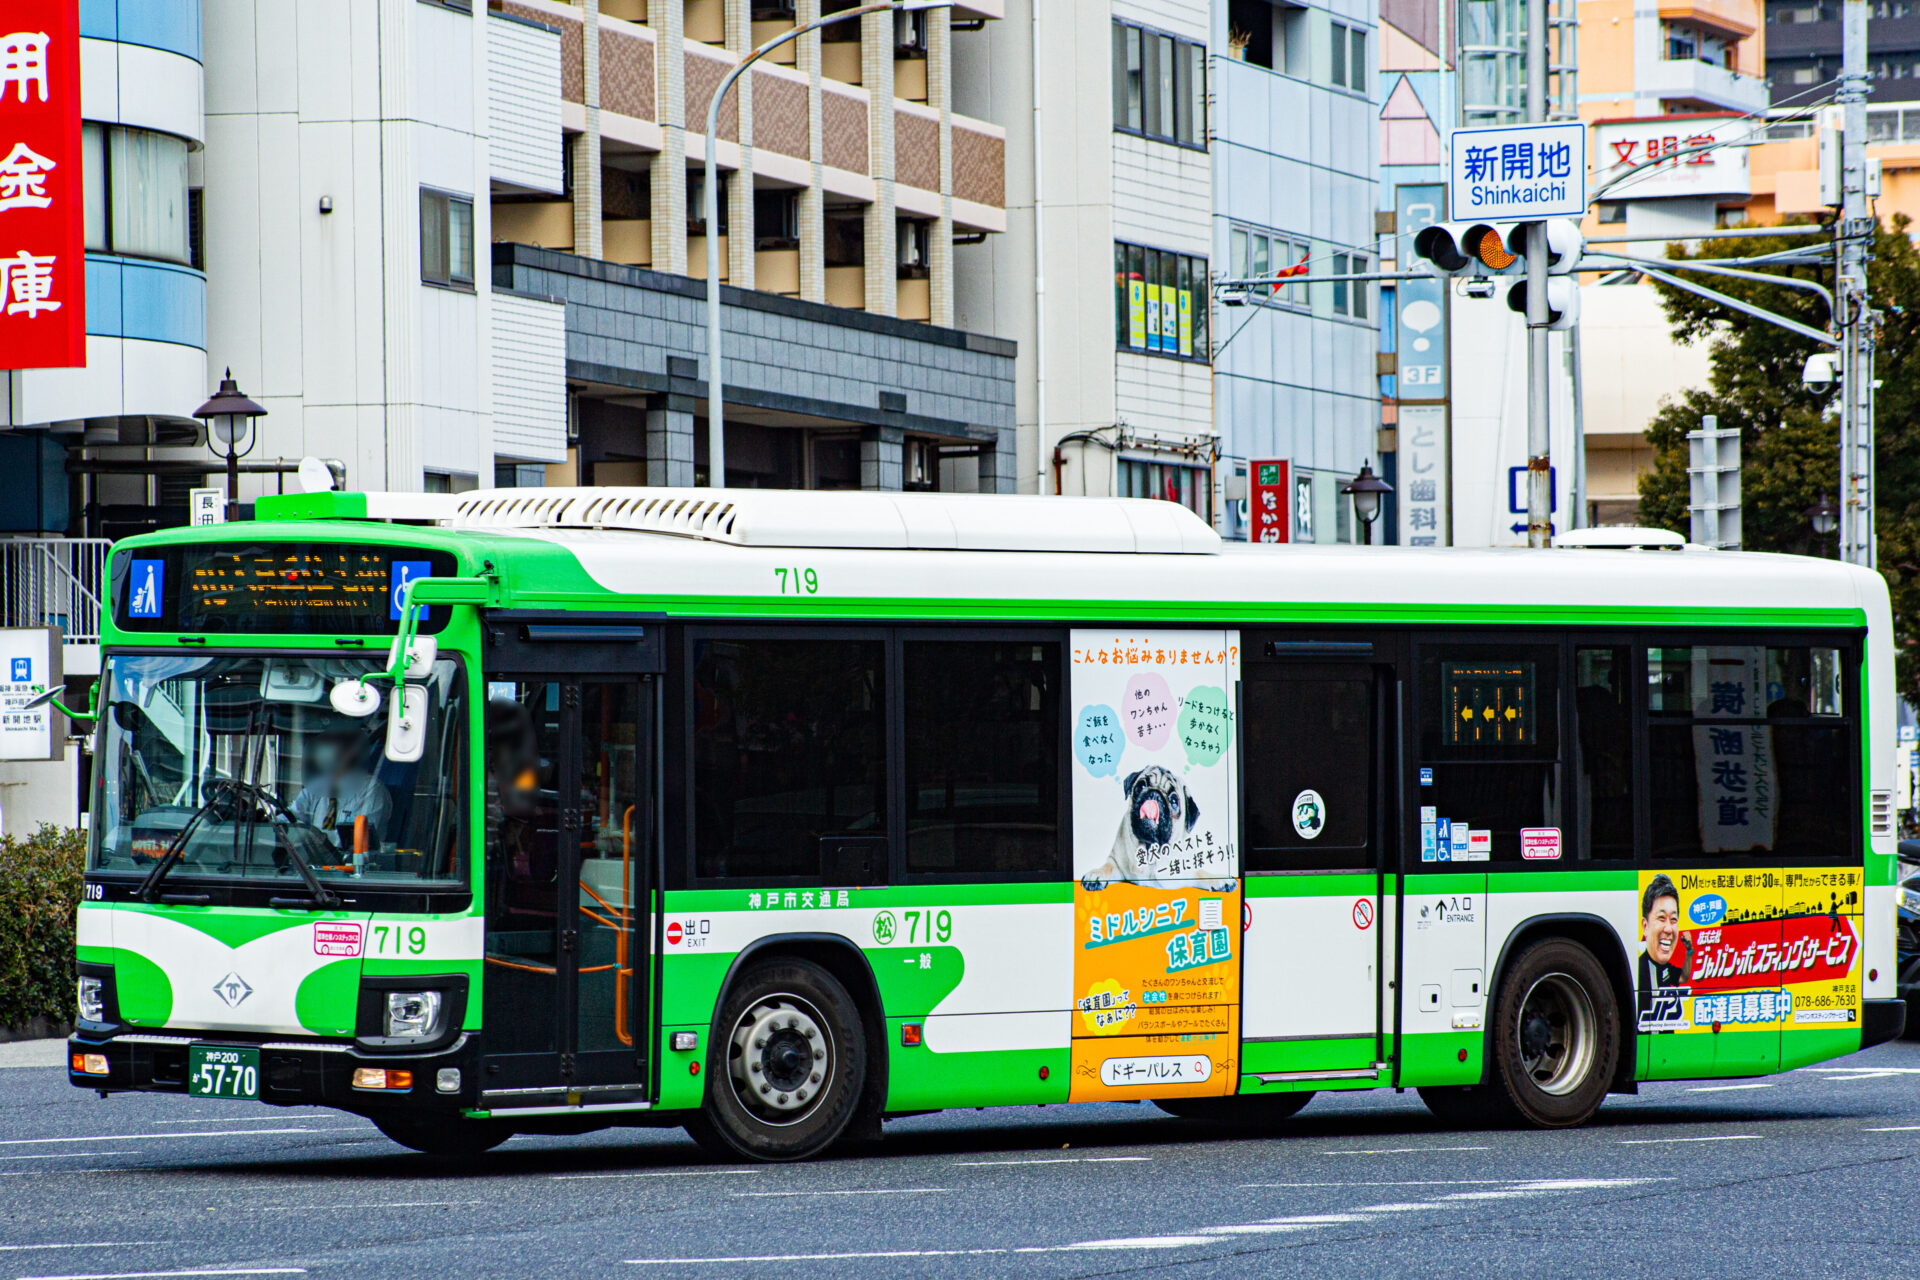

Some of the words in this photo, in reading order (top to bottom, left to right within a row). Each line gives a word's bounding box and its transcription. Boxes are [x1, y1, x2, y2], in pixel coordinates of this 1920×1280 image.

[1464, 141, 1571, 183] 新開地
[1471, 182, 1566, 206] Shinkaichi
[1407, 366, 1438, 383] 3F
[774, 567, 818, 594] 719
[1134, 688, 1151, 700] 他の
[1130, 704, 1168, 720] ワンちゃん
[1178, 696, 1235, 722] リードをつけると
[1085, 716, 1109, 728] ご飯を
[1189, 718, 1220, 736] 歩かなく
[1083, 735, 1114, 748] 食べなく
[1184, 736, 1221, 754] なっちゃう
[1088, 752, 1112, 765] なった
[1135, 830, 1214, 868] 愛犬のベストを
[86, 884, 103, 900] 719
[748, 890, 850, 909] 神戸市交通局
[1450, 897, 1472, 912] 入口
[1089, 898, 1188, 942] ミドルシニア
[1447, 913, 1474, 922] ENTRANCE
[1700, 912, 1718, 922] エリア
[685, 918, 711, 936] 出口
[904, 910, 952, 944] 719
[374, 926, 426, 954] 719
[687, 937, 707, 948] EXIT
[1166, 926, 1230, 968] 保育園
[903, 953, 932, 970] 一般
[1142, 977, 1225, 988] たくさんのワンちゃんと交流して
[1641, 988, 1690, 1022] JPS
[1696, 990, 1791, 1024] 配達員募集中
[1795, 994, 1856, 1008] 078-686-7630
[201, 1063, 256, 1096] 57-70
[1111, 1062, 1183, 1080] ドギーパレス
